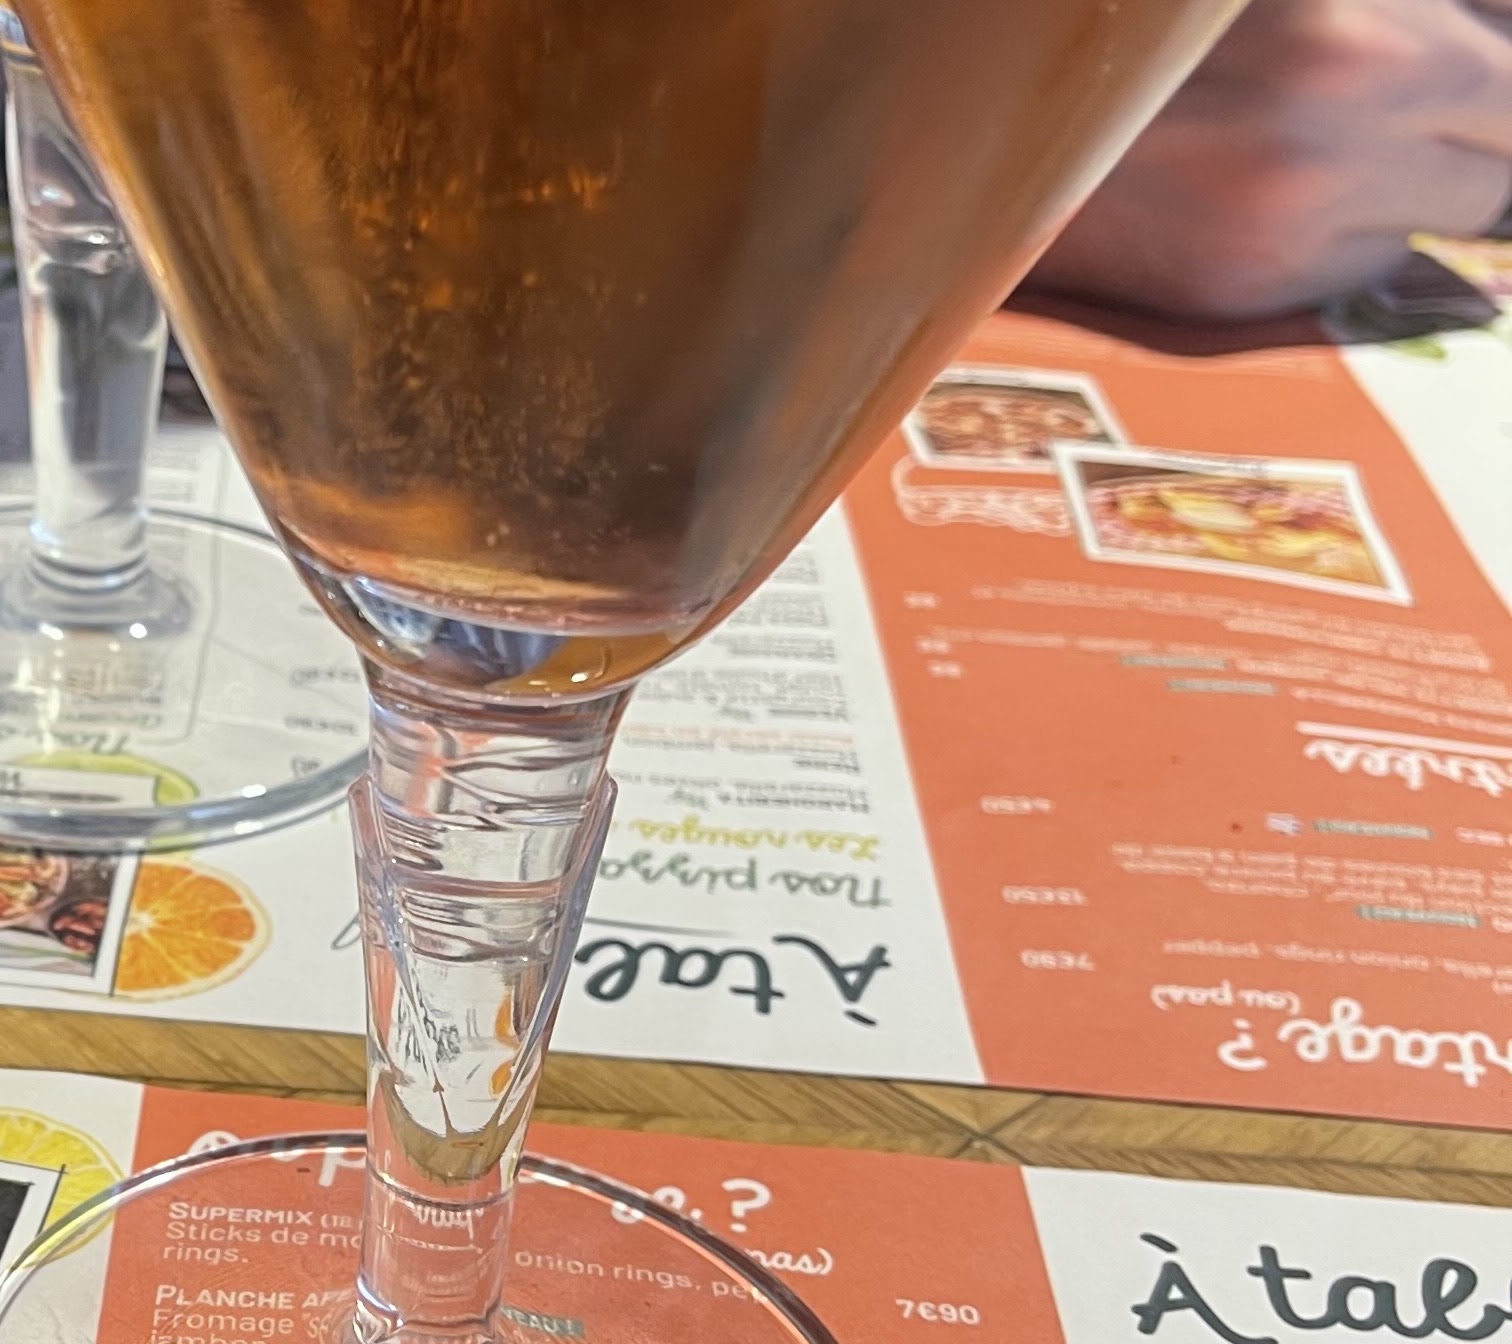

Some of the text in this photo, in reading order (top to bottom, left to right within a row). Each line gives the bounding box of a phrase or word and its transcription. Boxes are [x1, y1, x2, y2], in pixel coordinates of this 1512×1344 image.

[165, 1222, 309, 1246] Sticks de
[154, 1284, 294, 1310] PLANCHE
[152, 1308, 295, 1336] Fromage
[894, 1298, 981, 1327] 7€90
